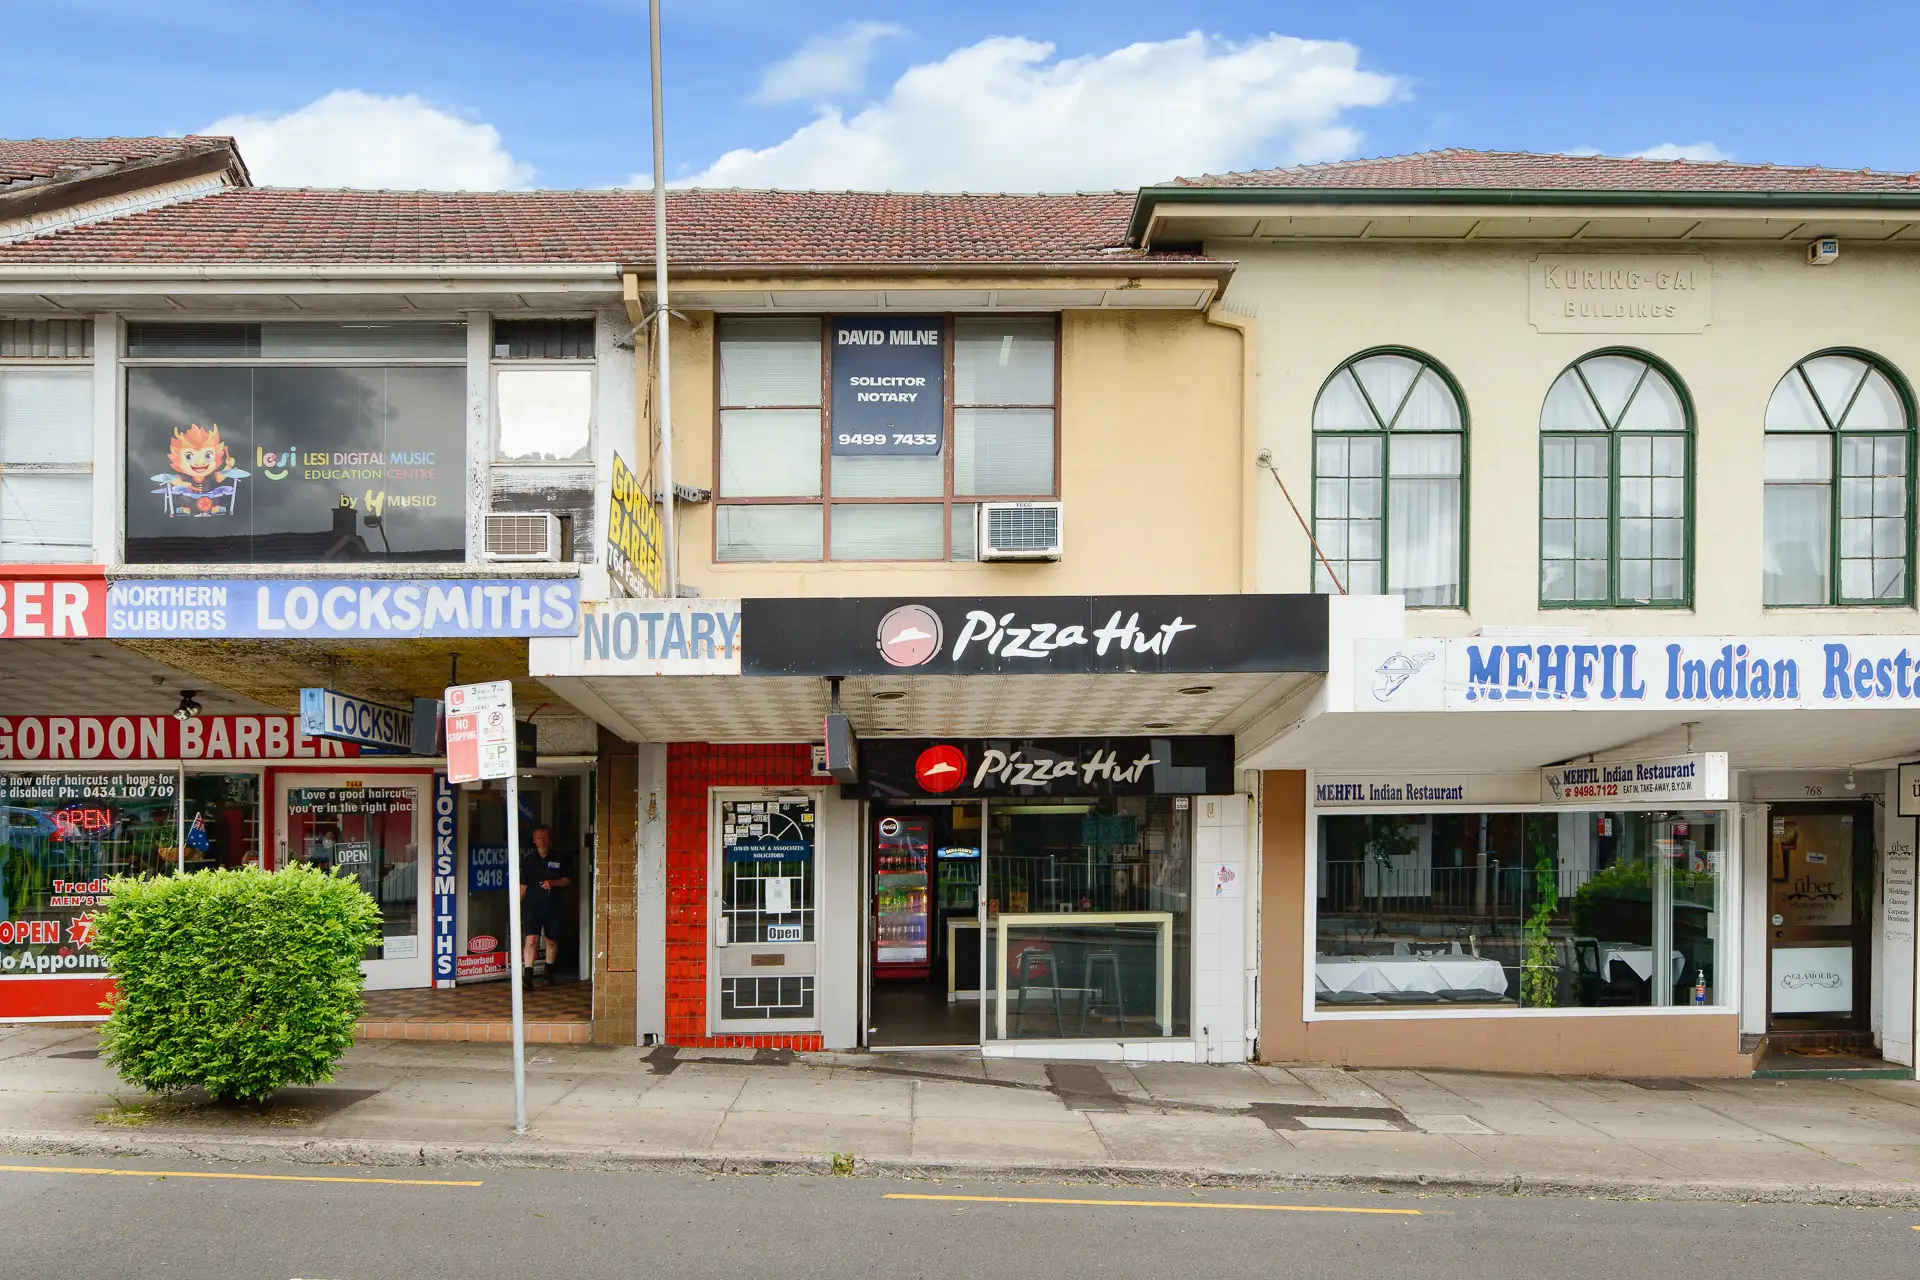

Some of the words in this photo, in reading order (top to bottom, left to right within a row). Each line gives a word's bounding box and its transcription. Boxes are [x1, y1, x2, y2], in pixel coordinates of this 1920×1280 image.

[1822, 243, 1837, 253] ADT
[1544, 265, 1696, 290] KURING-GAI
[1565, 299, 1677, 318] BUILDINGS
[838, 330, 884, 346] DAVID
[889, 330, 938, 346] MILNE
[850, 377, 926, 386] SOLICITOR
[857, 392, 918, 402] NOTARY
[838, 434, 887, 445] 9499
[892, 434, 937, 445] 7433
[257, 446, 296, 468] lesi
[303, 453, 329, 466] LESI
[333, 452, 386, 465] DIGITAL
[390, 452, 436, 465] MUSIC
[304, 469, 382, 480] EDUCATION
[386, 469, 436, 479] CENTRE
[340, 494, 358, 509] by
[387, 495, 437, 507] MUSIC
[613, 455, 663, 556] GORDON
[609, 498, 661, 597] BARBER
[608, 542, 624, 577] 764
[111, 586, 227, 607] NORTHERN
[0, 583, 88, 636] ER
[257, 586, 574, 631] LOCKSMITHS
[111, 610, 227, 632] SUBURBS
[584, 612, 741, 660] NOTARY
[953, 611, 1088, 661] Pizza
[1094, 613, 1196, 656] Hut
[1466, 644, 1646, 701] MEHFIL
[1665, 644, 1799, 701] Indian
[471, 687, 477, 695] 3
[332, 697, 414, 746] LOCKSMI
[455, 719, 469, 730] NO
[974, 749, 1090, 789] Pizza
[1085, 749, 1160, 784] Hut
[1563, 768, 1599, 785] MEHFIL
[1602, 766, 1633, 782] Indian
[1636, 761, 1695, 780] Restaurant
[10, 776, 33, 786] now
[35, 774, 62, 786] offer
[64, 774, 109, 786] haircuts
[111, 776, 123, 786] at
[126, 774, 155, 786] home
[158, 774, 175, 786] for
[9, 786, 54, 798] disabled
[58, 786, 79, 798] Ph:
[83, 786, 116, 798] 0434
[121, 786, 145, 798] 100
[150, 786, 174, 797] 709
[301, 789, 326, 799] Love
[329, 791, 336, 799] a
[339, 788, 365, 801] good
[1316, 784, 1364, 801] MEHFIL
[1369, 783, 1402, 800] Indian
[1406, 783, 1463, 800] Restaurant
[1573, 784, 1618, 797] 9498.7122
[1805, 785, 1823, 796] 768
[289, 803, 323, 816] you're
[326, 803, 337, 812] in
[341, 802, 358, 812] the
[361, 802, 387, 814] right
[389, 802, 417, 814] place
[56, 809, 111, 830] OPEN
[1891, 840, 1910, 852] über
[338, 850, 368, 863] OPEN
[473, 848, 510, 866] LOCKS
[434, 776, 456, 974] LOCKSMITHS
[476, 870, 503, 887] 9418
[1886, 878, 1913, 886] Commercial
[53, 879, 111, 893] Tradi
[1795, 876, 1835, 893] über
[1888, 888, 1911, 896] Weddings
[51, 896, 94, 906] MEN'S
[1889, 898, 1909, 906] Glamour
[1887, 908, 1910, 916] Corporate
[1887, 915, 1910, 923] Headshots
[0, 921, 60, 944] OPEN
[769, 927, 800, 940] Open
[457, 955, 494, 967] Authorised
[457, 965, 485, 975] Service
[1791, 972, 1832, 980] GLAMOUR
